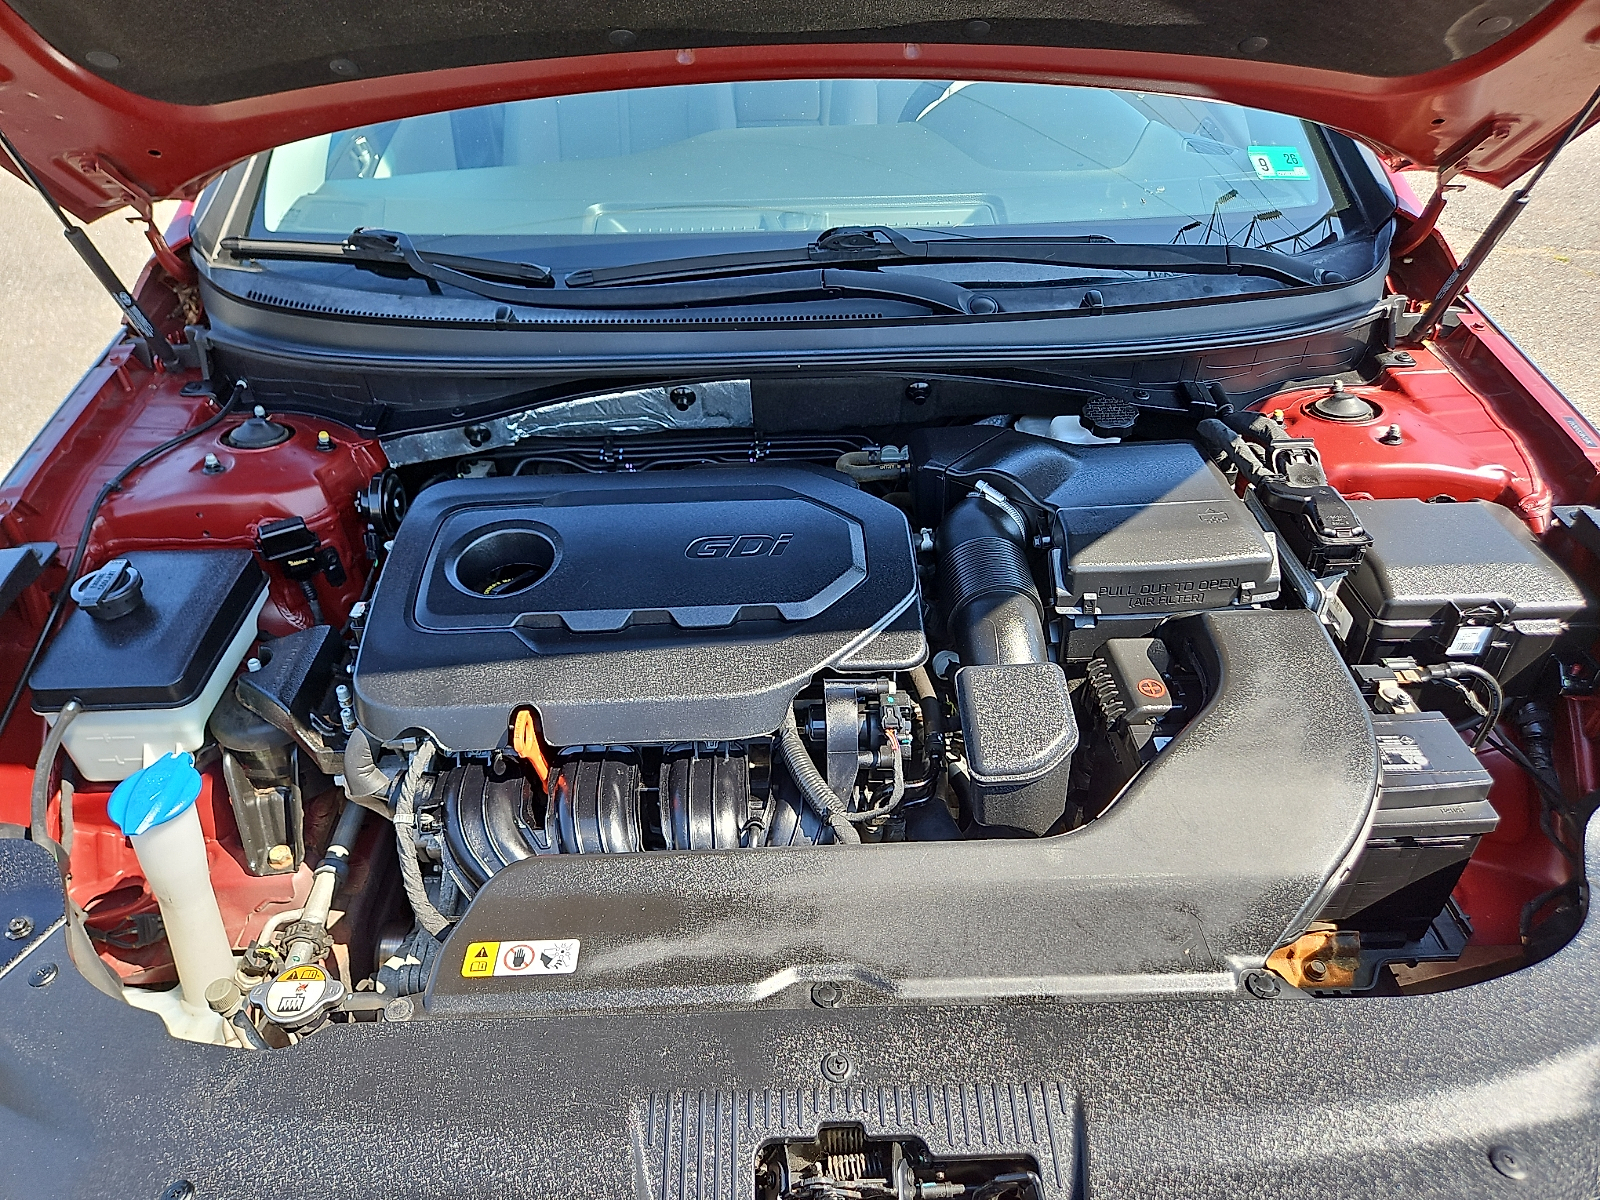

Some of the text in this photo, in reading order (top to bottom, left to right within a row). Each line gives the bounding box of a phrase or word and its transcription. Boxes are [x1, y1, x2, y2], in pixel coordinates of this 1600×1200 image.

[1258, 158, 1269, 171] 9
[1283, 153, 1298, 164] 26
[684, 533, 794, 559] GDi
[1098, 578, 1239, 598] PULL OUT TO OPEN
